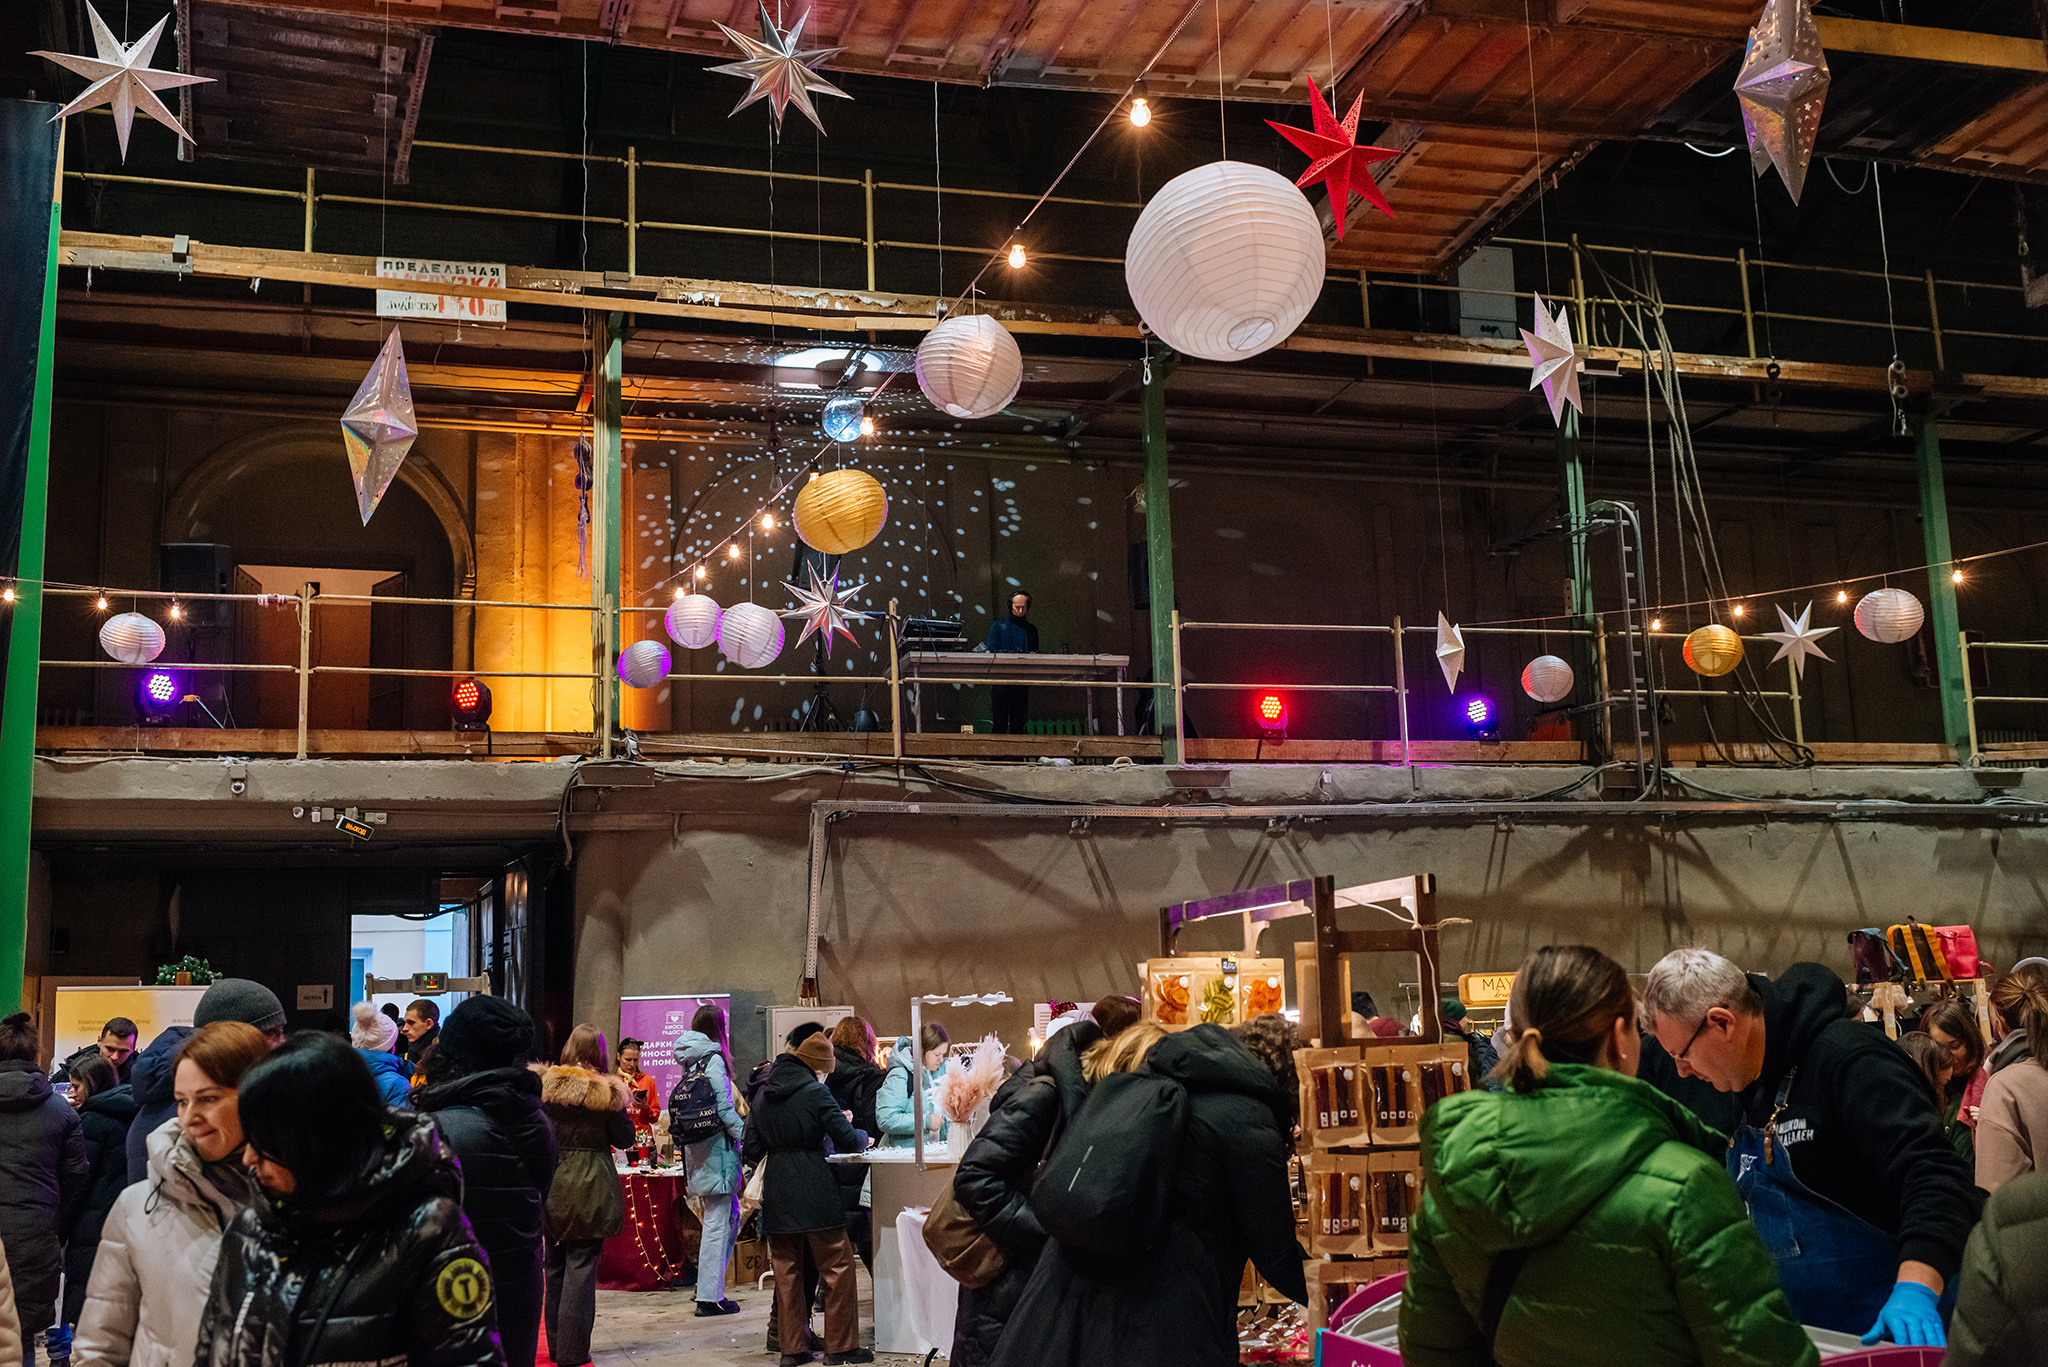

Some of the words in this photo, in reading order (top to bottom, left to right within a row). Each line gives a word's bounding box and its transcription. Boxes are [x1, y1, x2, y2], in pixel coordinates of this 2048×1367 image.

[383, 261, 500, 276] ПРЕДЕЛЬНАЯ
[640, 1041, 672, 1049] ДАРКИ
[652, 1059, 678, 1067] ПОМО
